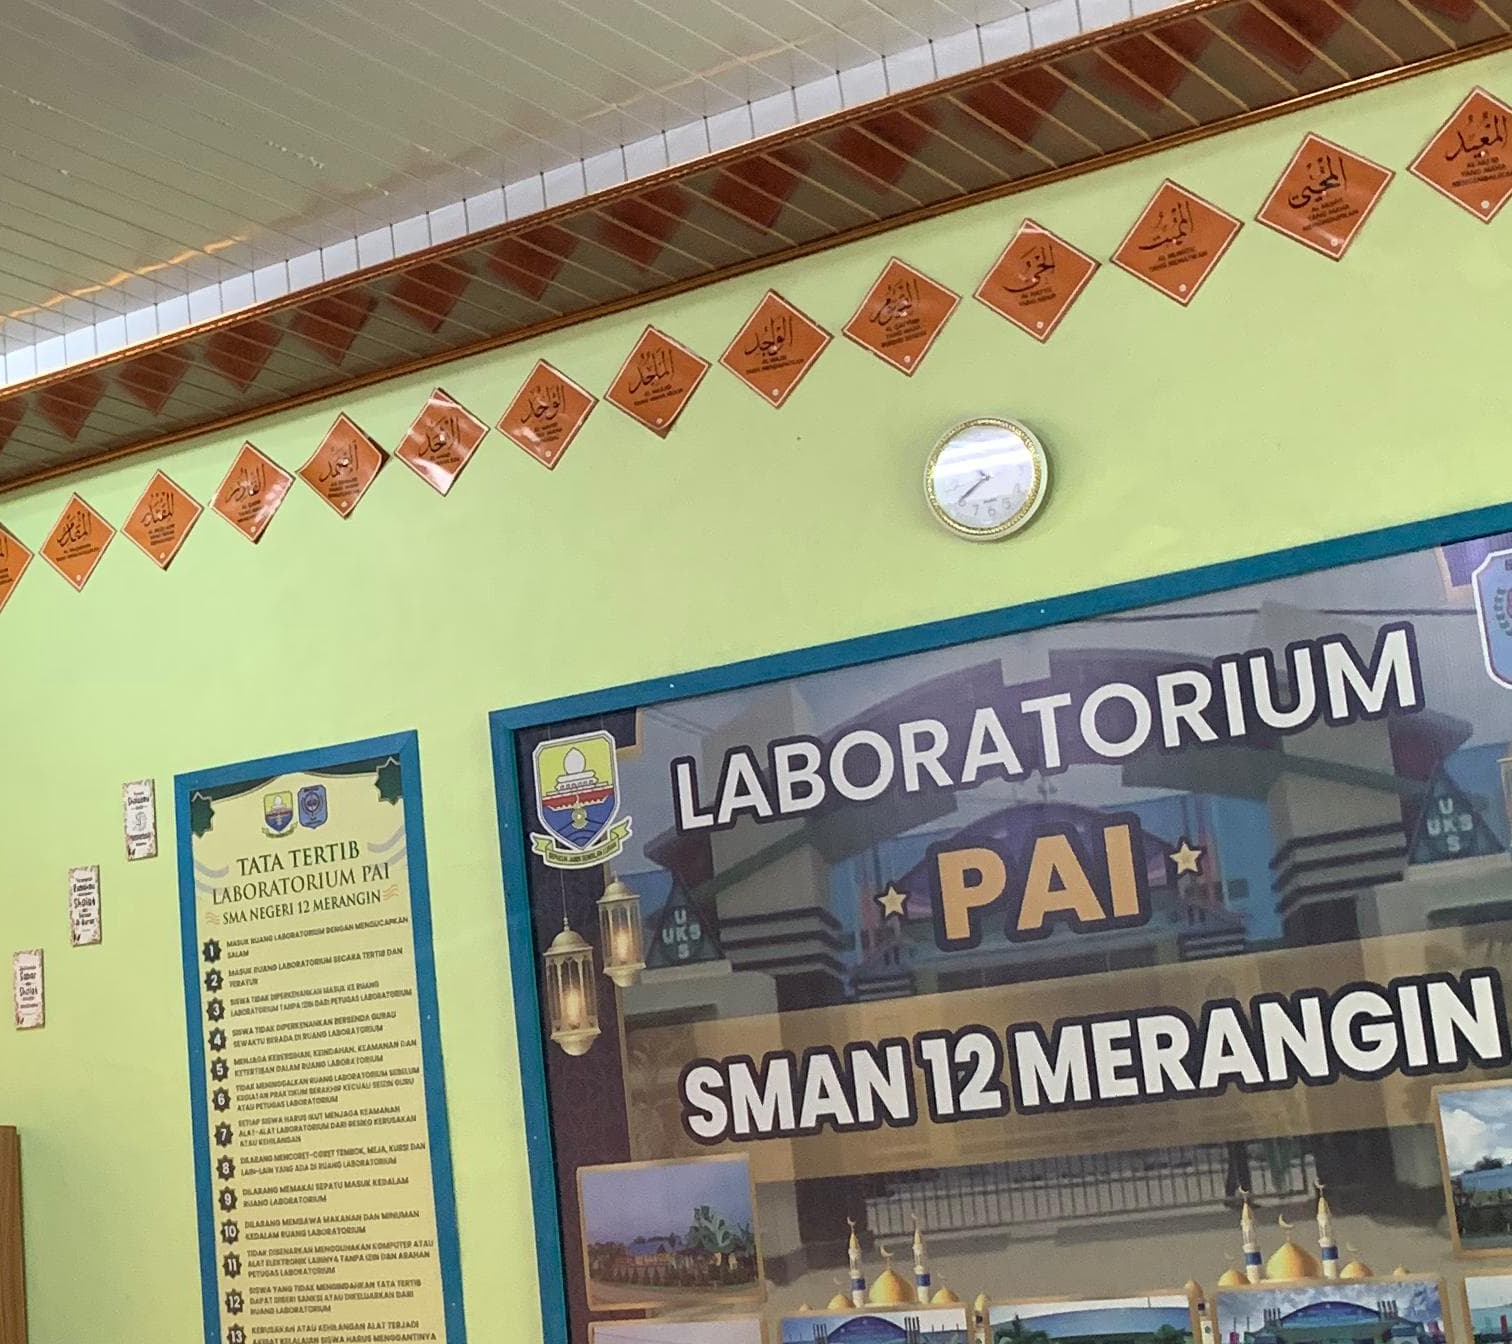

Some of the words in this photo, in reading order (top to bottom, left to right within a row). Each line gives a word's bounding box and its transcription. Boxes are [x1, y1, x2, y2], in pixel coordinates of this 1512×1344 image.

[675, 628, 1417, 831] LABORATORIUM
[212, 867, 355, 905] LABORATORIUM
[236, 851, 284, 876] TATA
[288, 839, 360, 868] TERTIB
[935, 824, 1142, 941] PAI
[249, 901, 293, 921] NEGERI
[312, 889, 380, 912] MERANGIN
[687, 1044, 910, 1138] SMAN
[923, 1032, 1003, 1113] 12
[1013, 976, 1502, 1109] MERANGIN
